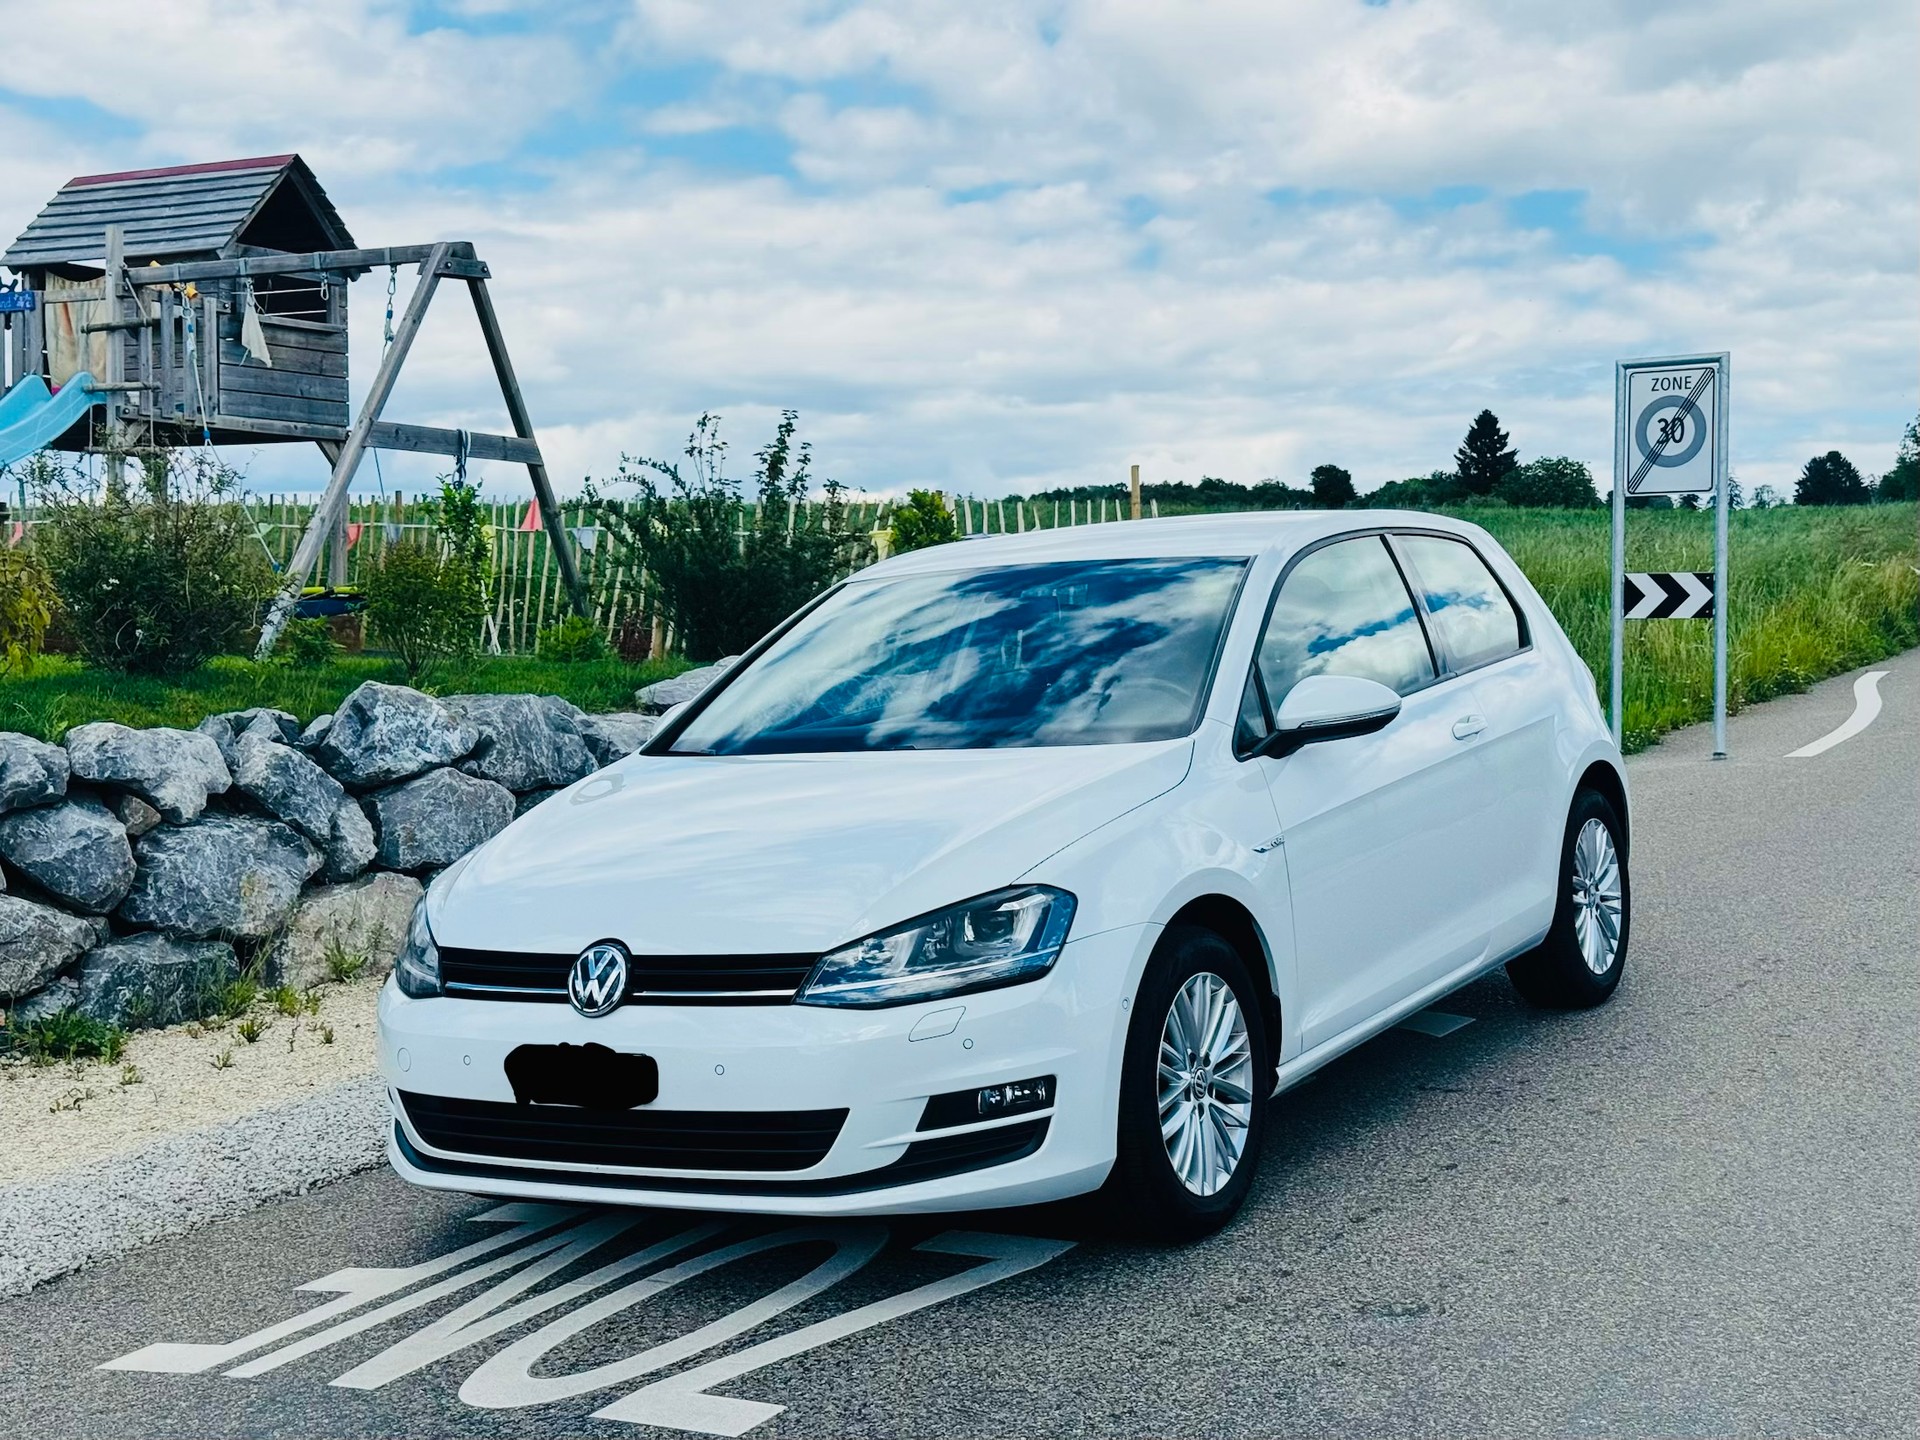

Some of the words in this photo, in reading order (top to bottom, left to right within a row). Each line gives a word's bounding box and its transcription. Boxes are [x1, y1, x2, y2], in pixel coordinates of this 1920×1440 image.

[1651, 376, 1692, 392] ZONE
[1657, 416, 1685, 444] 30
[569, 945, 626, 1011] VW
[98, 1203, 1079, 1437] ZONE
